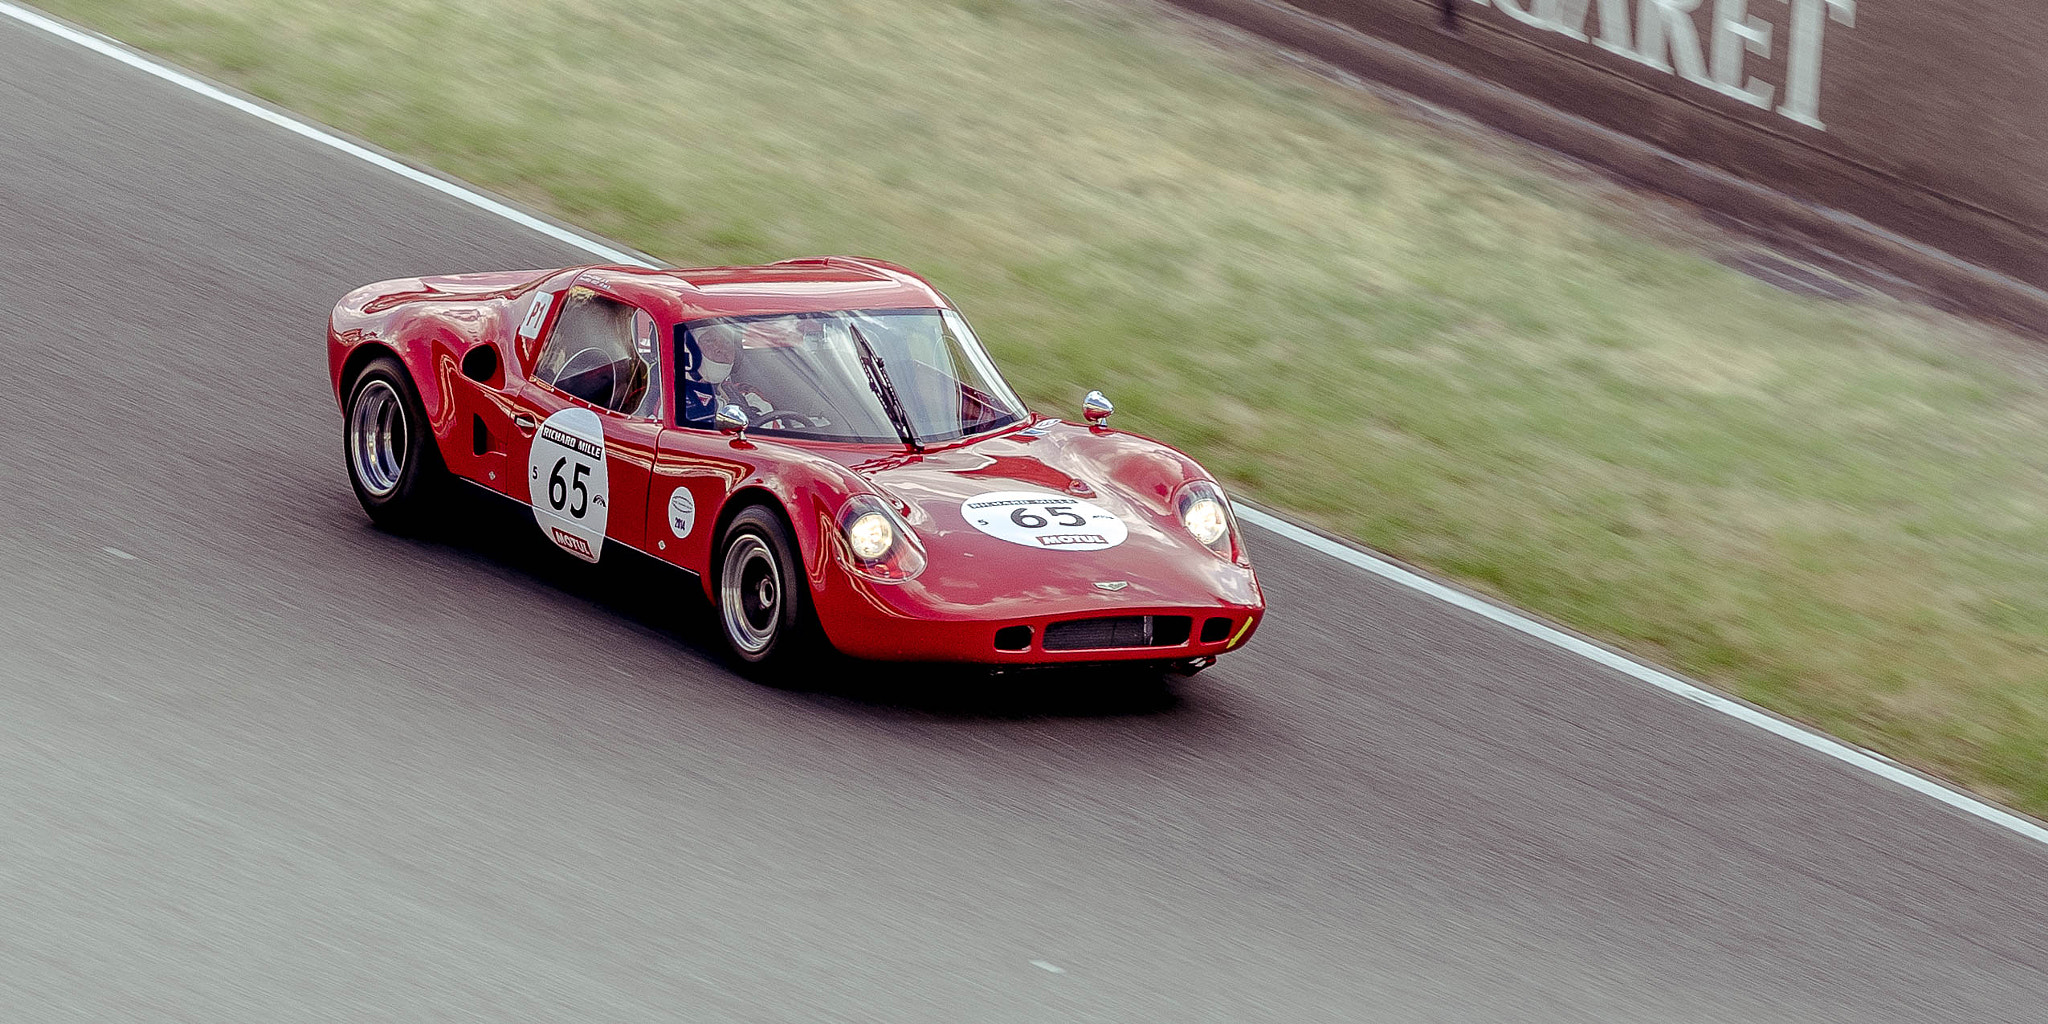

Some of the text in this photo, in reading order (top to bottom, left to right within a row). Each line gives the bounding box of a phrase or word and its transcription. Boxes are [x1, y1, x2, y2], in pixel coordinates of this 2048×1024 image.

[526, 301, 546, 329] P1
[543, 426, 601, 458] RICHARD MILLE
[549, 456, 591, 519] 65
[1010, 507, 1087, 529] 65
[554, 530, 591, 556] MOTUL
[1041, 534, 1106, 545] MOTUL
